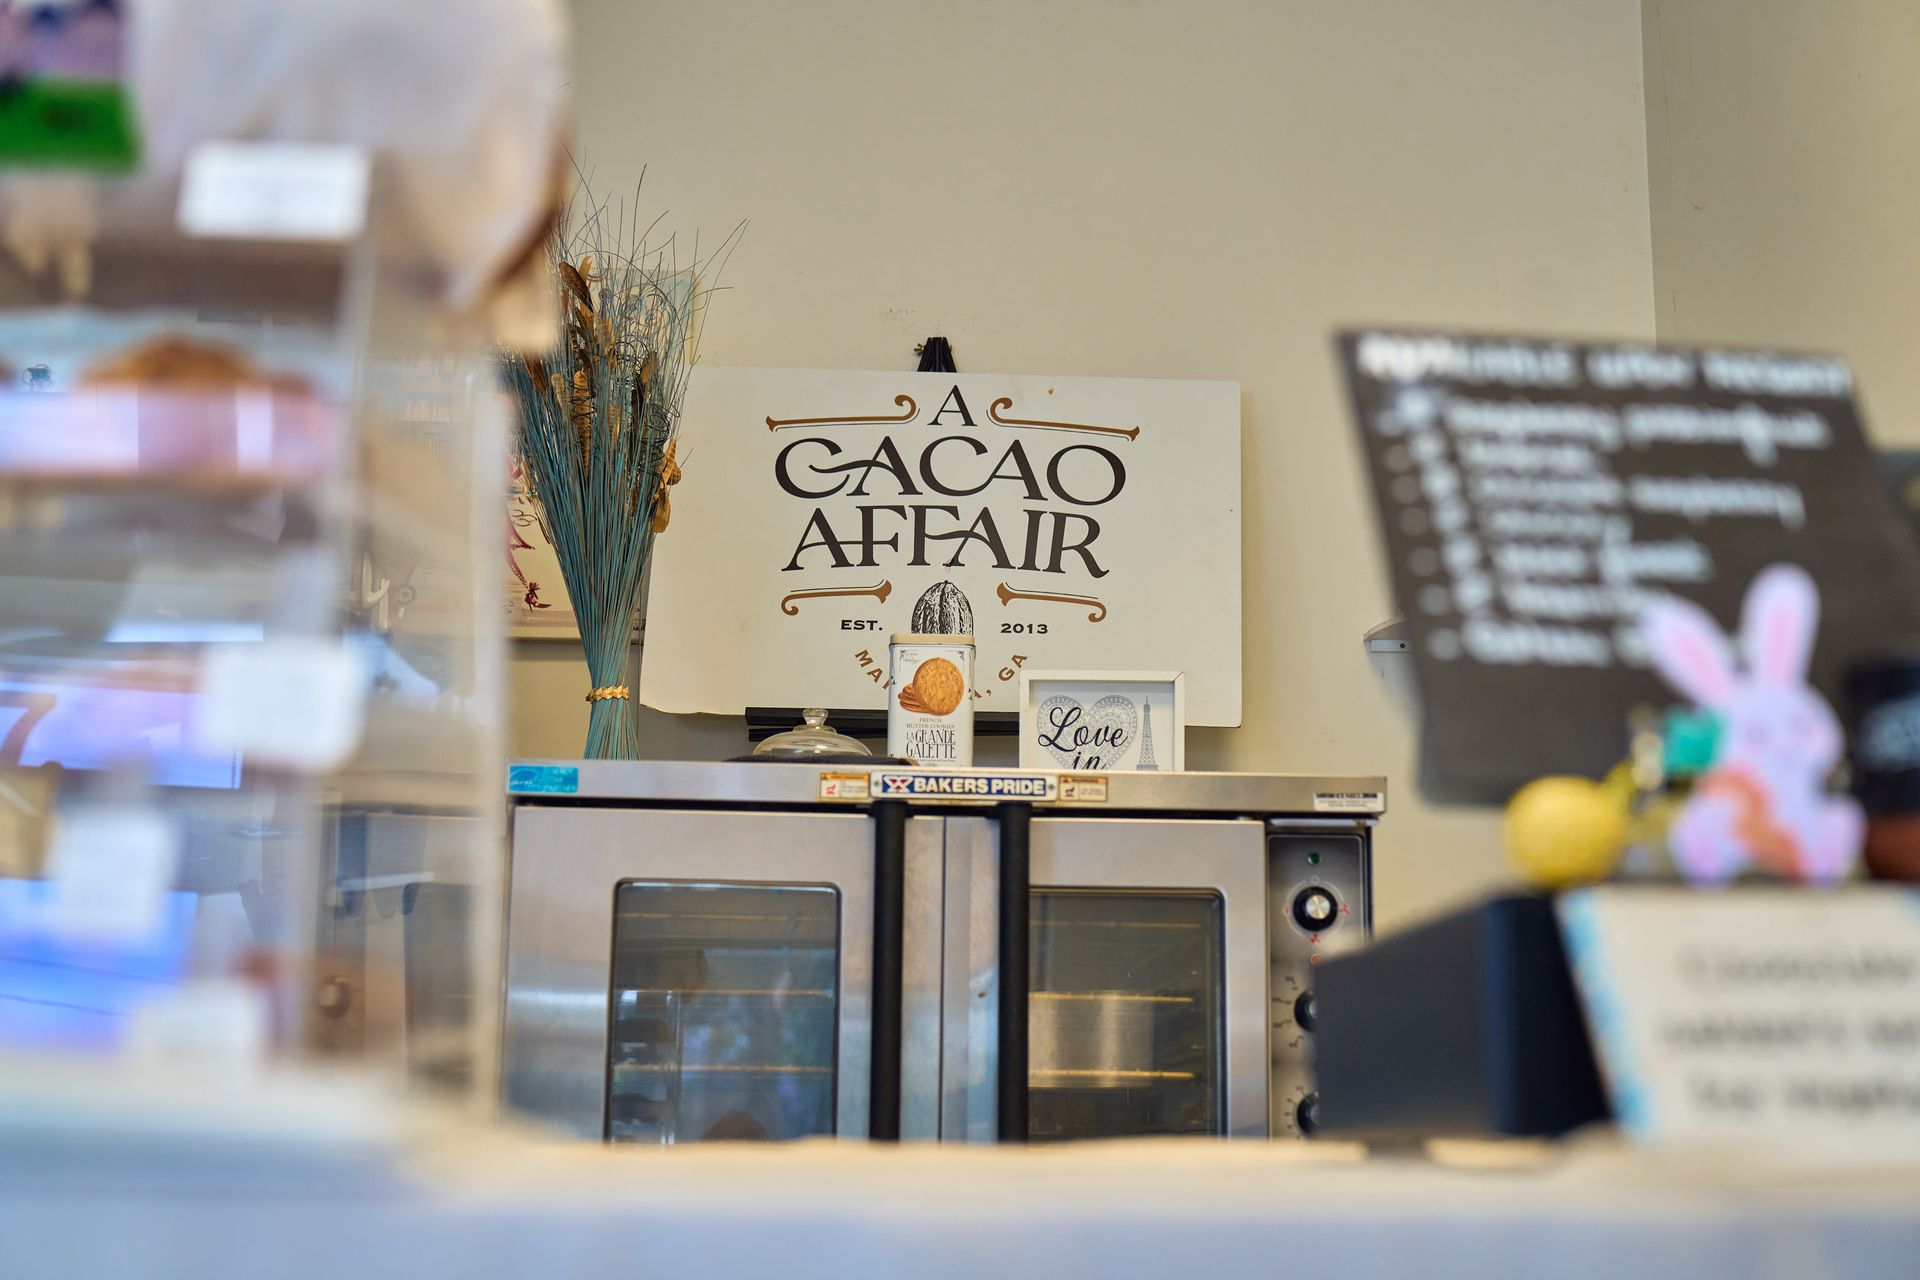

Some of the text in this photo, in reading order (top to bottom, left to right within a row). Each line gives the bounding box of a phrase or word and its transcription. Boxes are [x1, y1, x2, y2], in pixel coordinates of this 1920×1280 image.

[927, 385, 977, 427] A
[775, 436, 1126, 505] CACAO
[781, 504, 1109, 579] AFFAIR
[841, 619, 1048, 635] EST. 2013
[998, 654, 1028, 682] GA
[915, 729, 956, 745] GRANDE
[1038, 706, 1129, 753] Love
[906, 740, 957, 759] GALETTE
[913, 776, 1045, 795] BAKERS PRIDE
